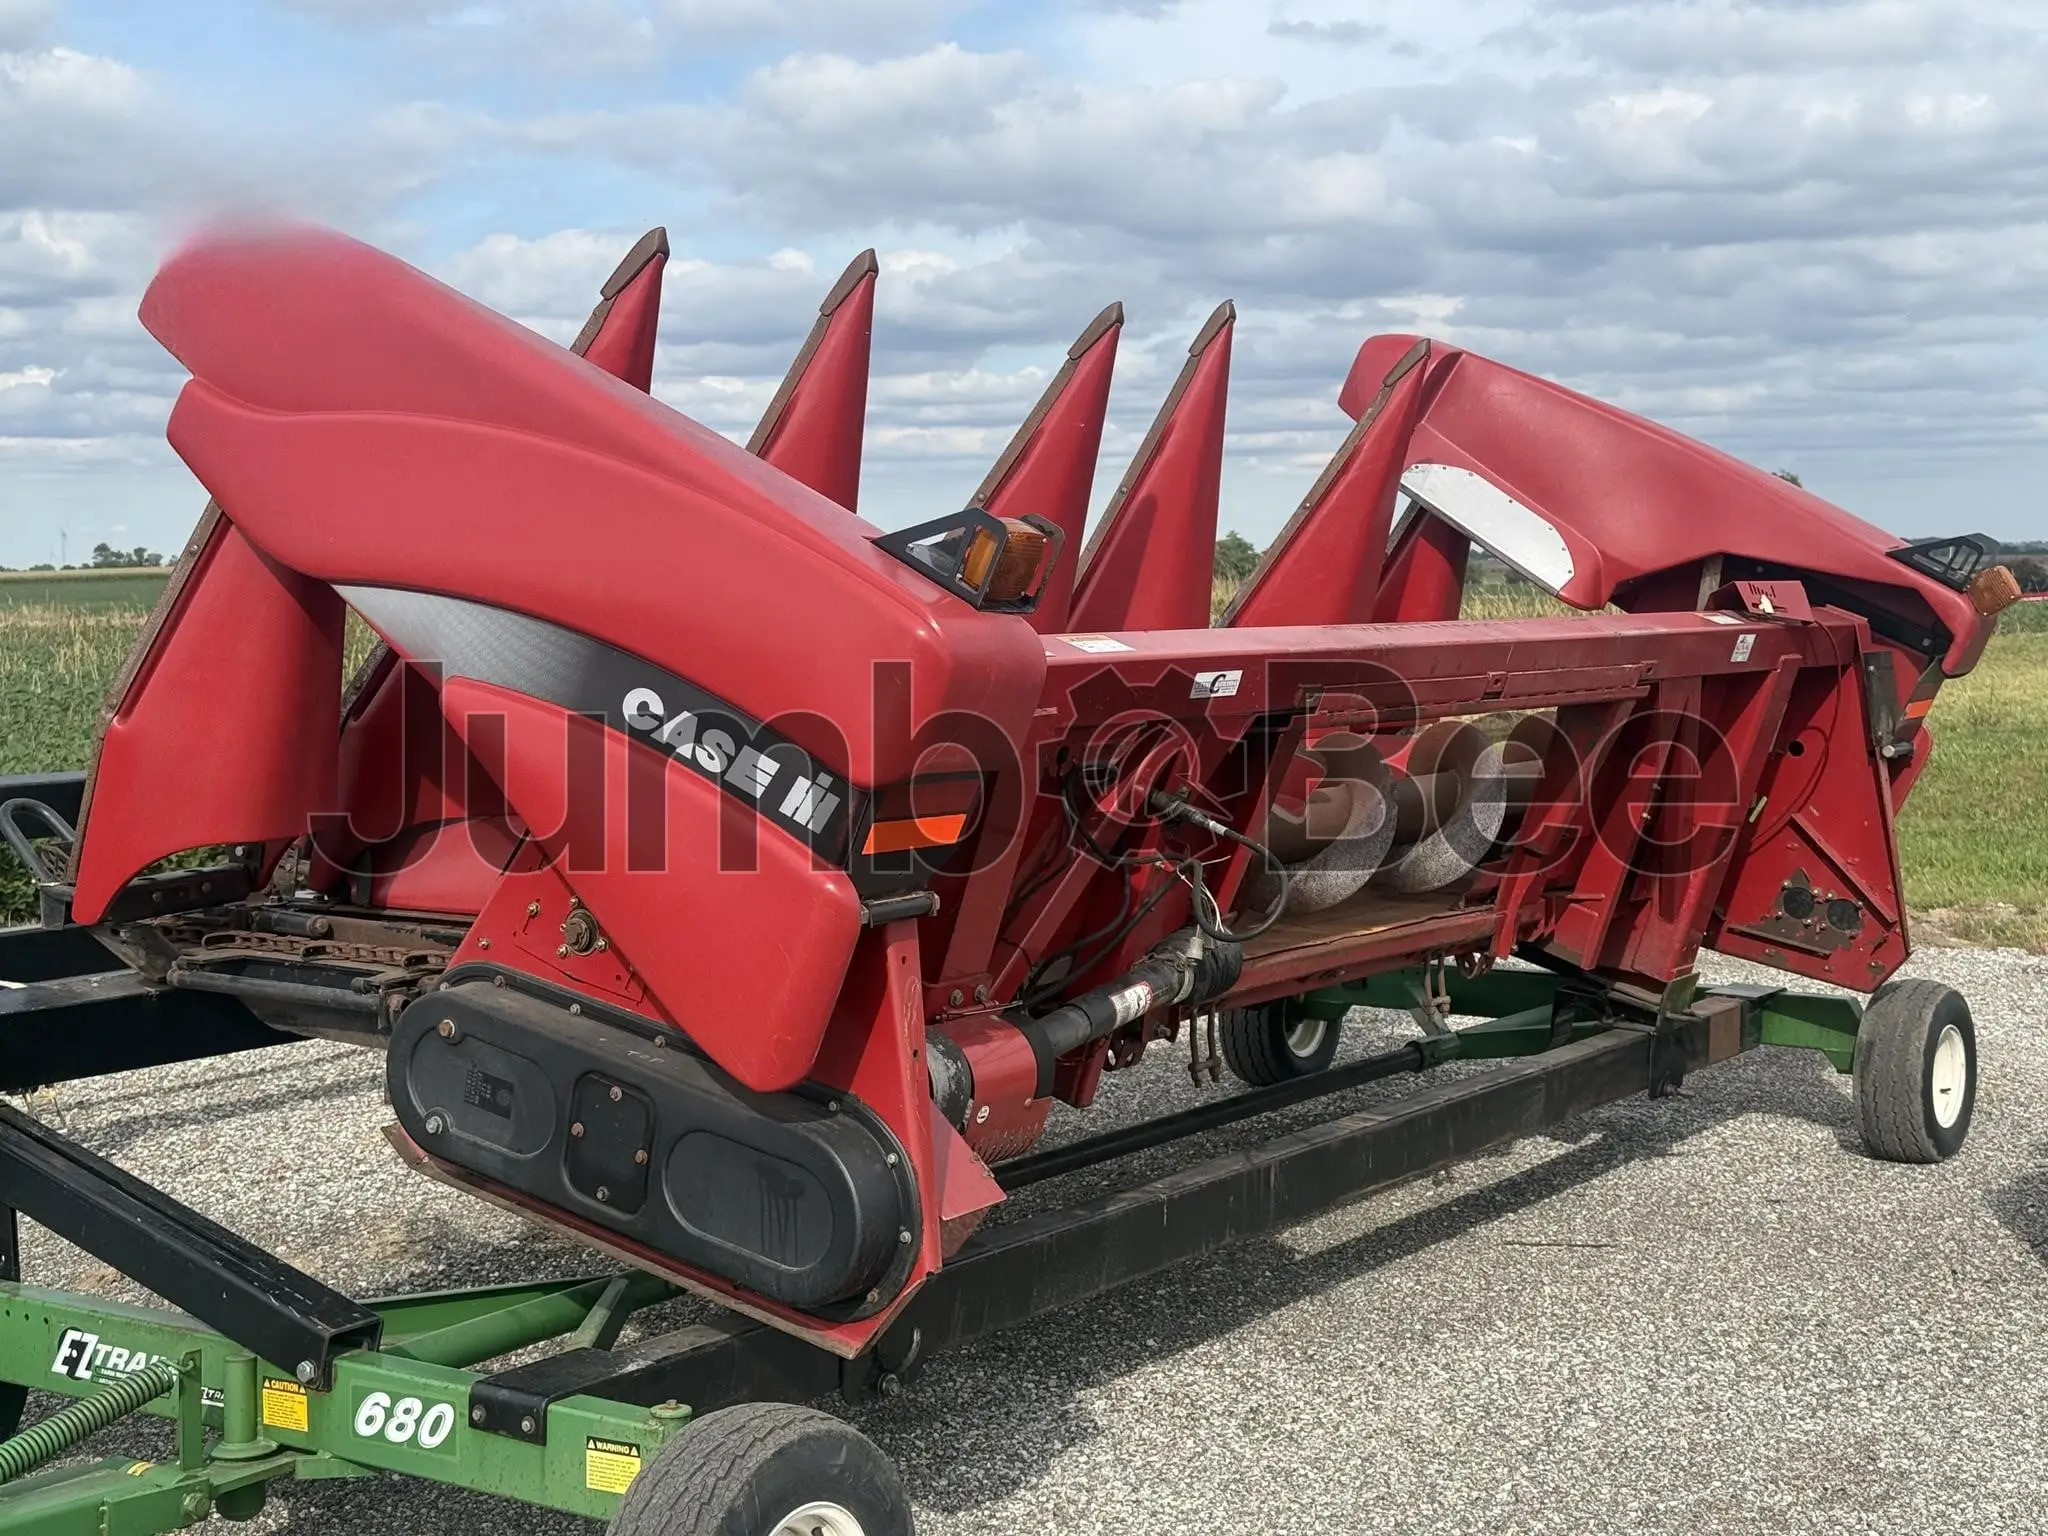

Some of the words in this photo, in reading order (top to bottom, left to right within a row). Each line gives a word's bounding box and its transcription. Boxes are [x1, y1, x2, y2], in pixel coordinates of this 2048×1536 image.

[622, 687, 781, 799] CASE
[271, 1379, 299, 1393] CAUTION
[354, 1391, 455, 1449] 680
[595, 1440, 630, 1455] WARNING
